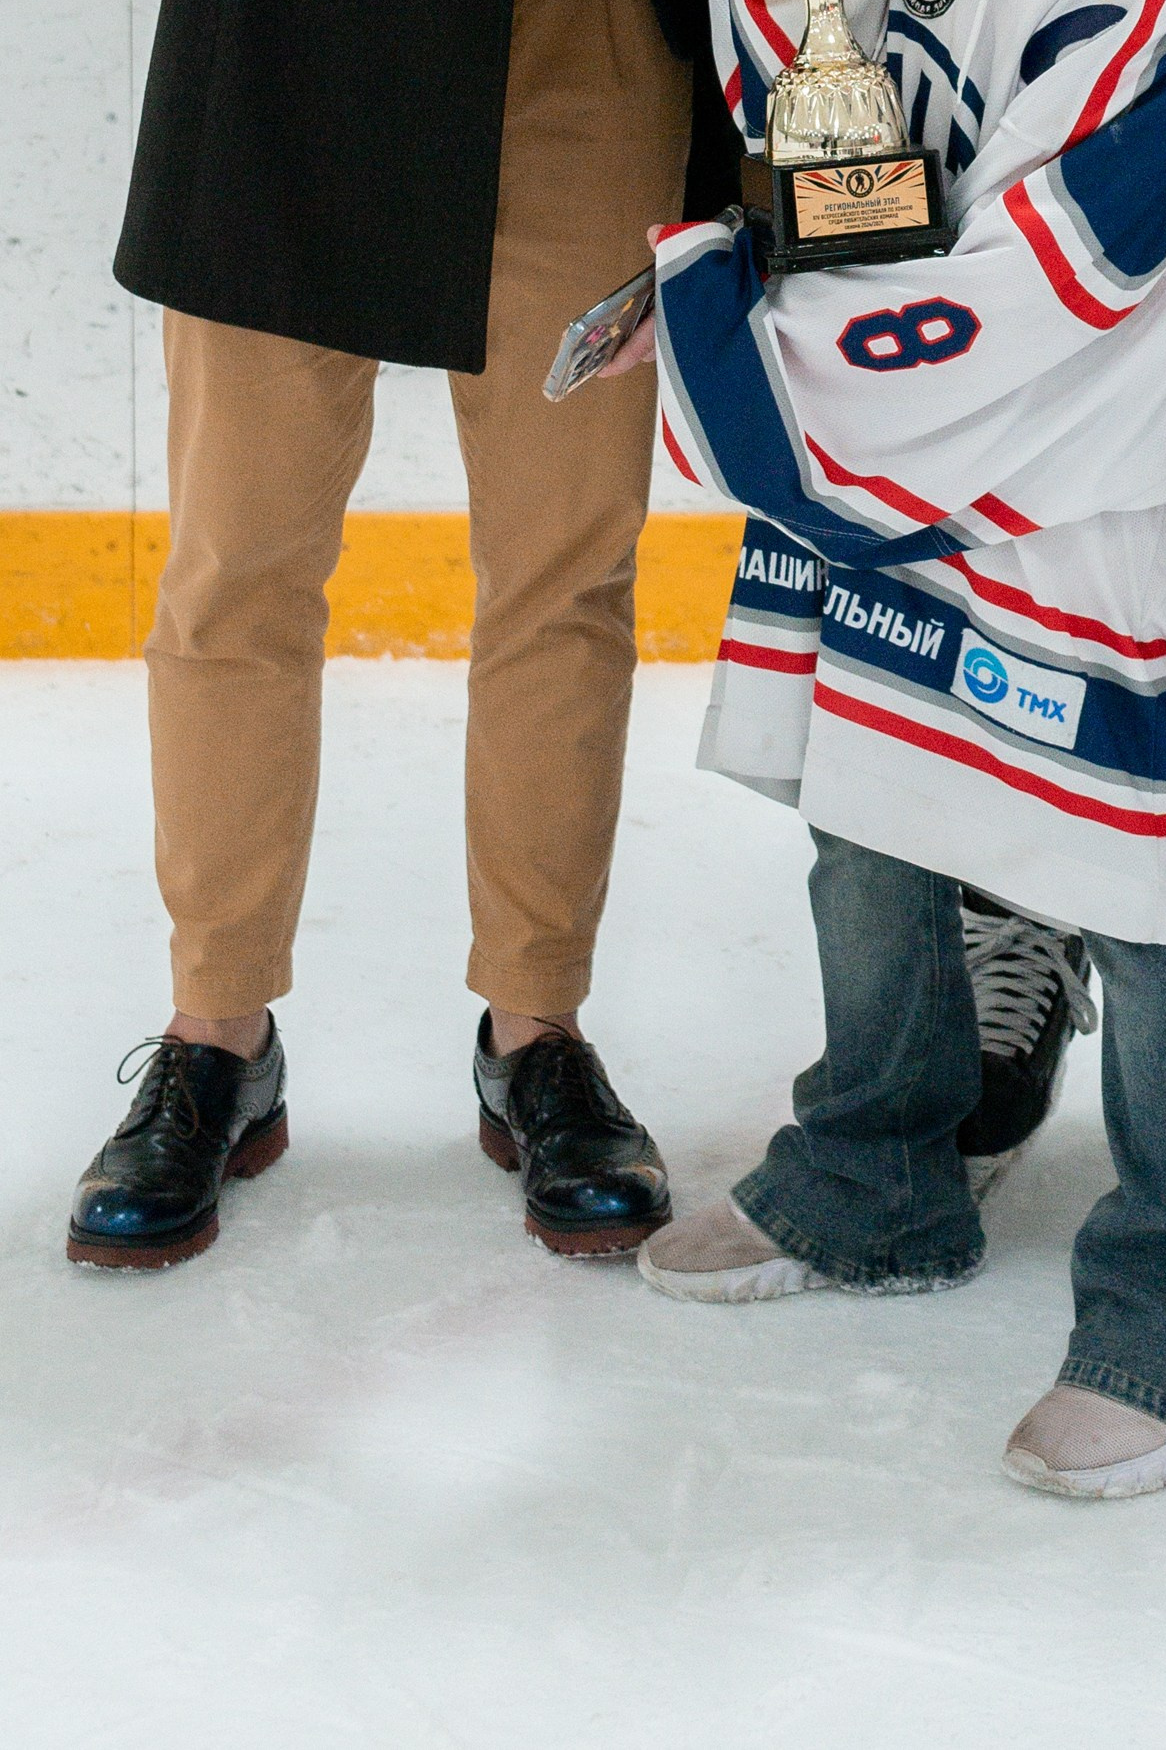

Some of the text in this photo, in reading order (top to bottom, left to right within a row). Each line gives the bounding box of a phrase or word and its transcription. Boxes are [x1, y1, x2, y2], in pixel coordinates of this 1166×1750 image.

[824, 197, 900, 212] РЕГИОНАЛЬНЫЙ ЭТАП
[836, 295, 982, 373] 8
[823, 584, 946, 661] ЛЬНЫЙ
[1016, 686, 1068, 723] ТМХ
